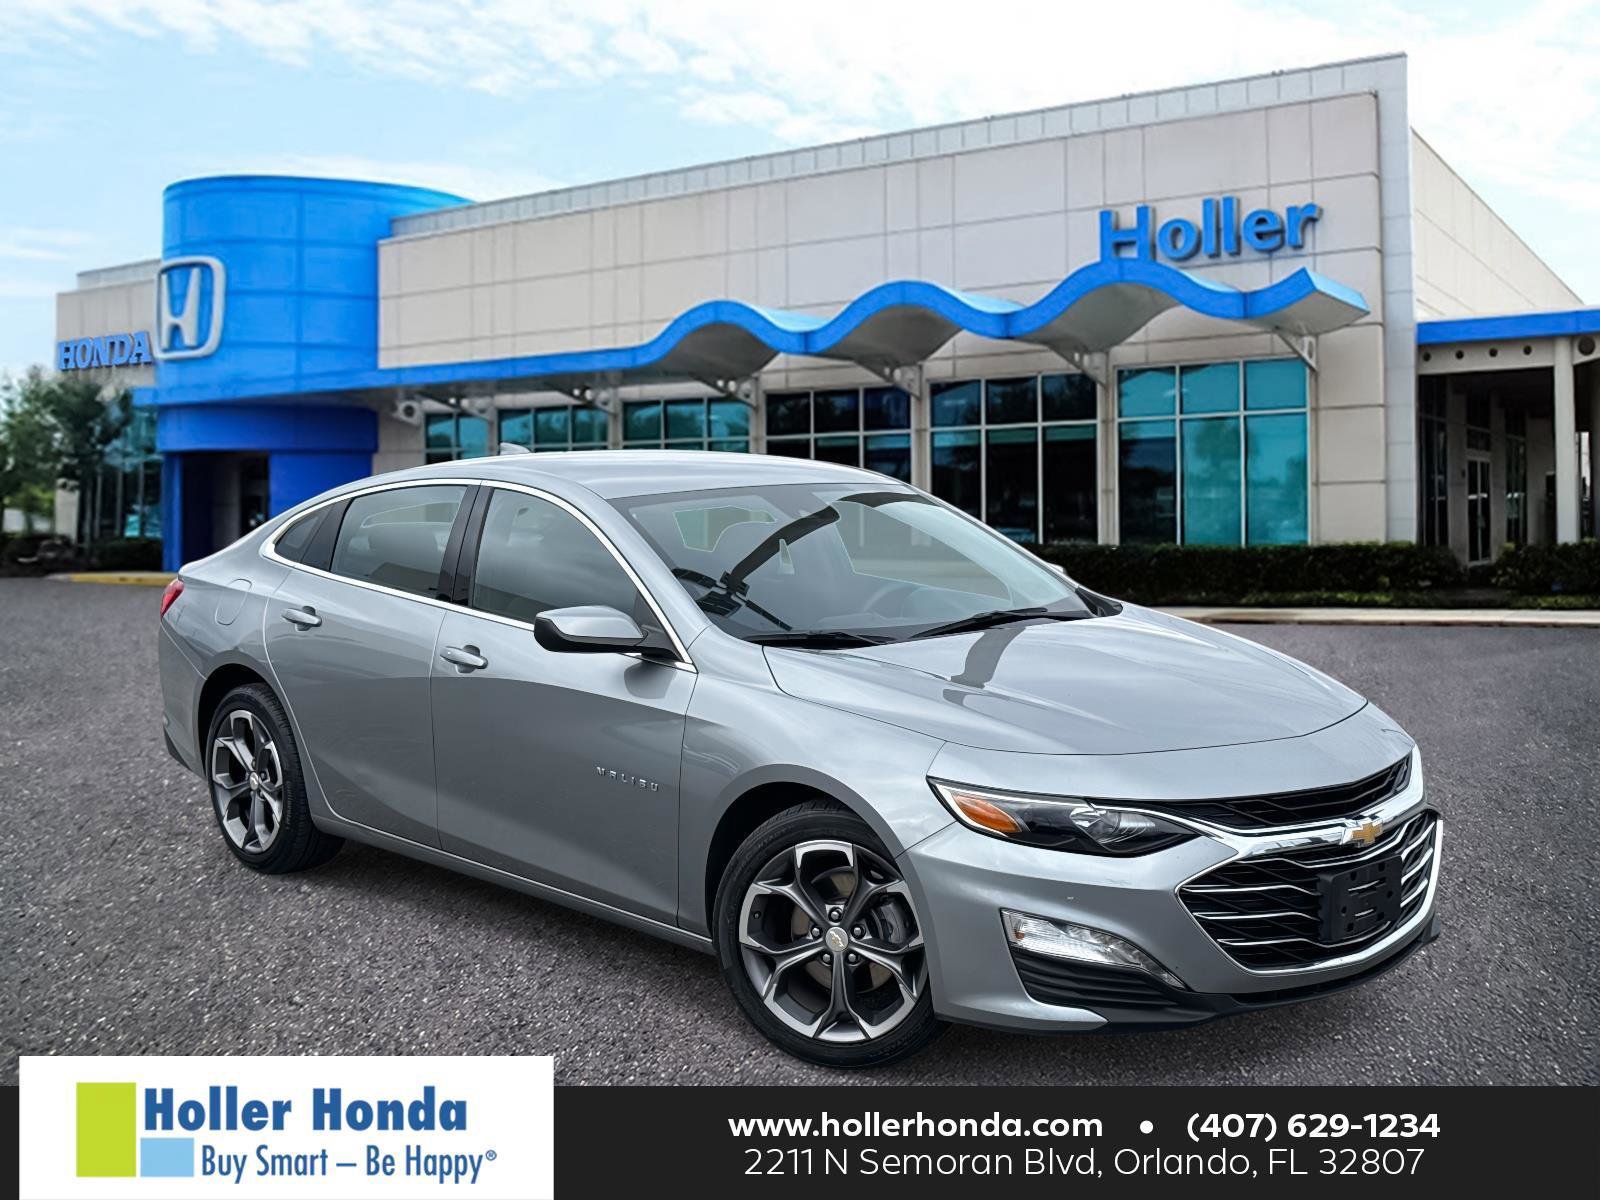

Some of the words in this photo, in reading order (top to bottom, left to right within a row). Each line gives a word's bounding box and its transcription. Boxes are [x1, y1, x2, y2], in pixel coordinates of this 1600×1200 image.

[1100, 196, 1322, 261] Holler
[57, 331, 152, 371] HONDA
[596, 766, 659, 792] MALIBU
